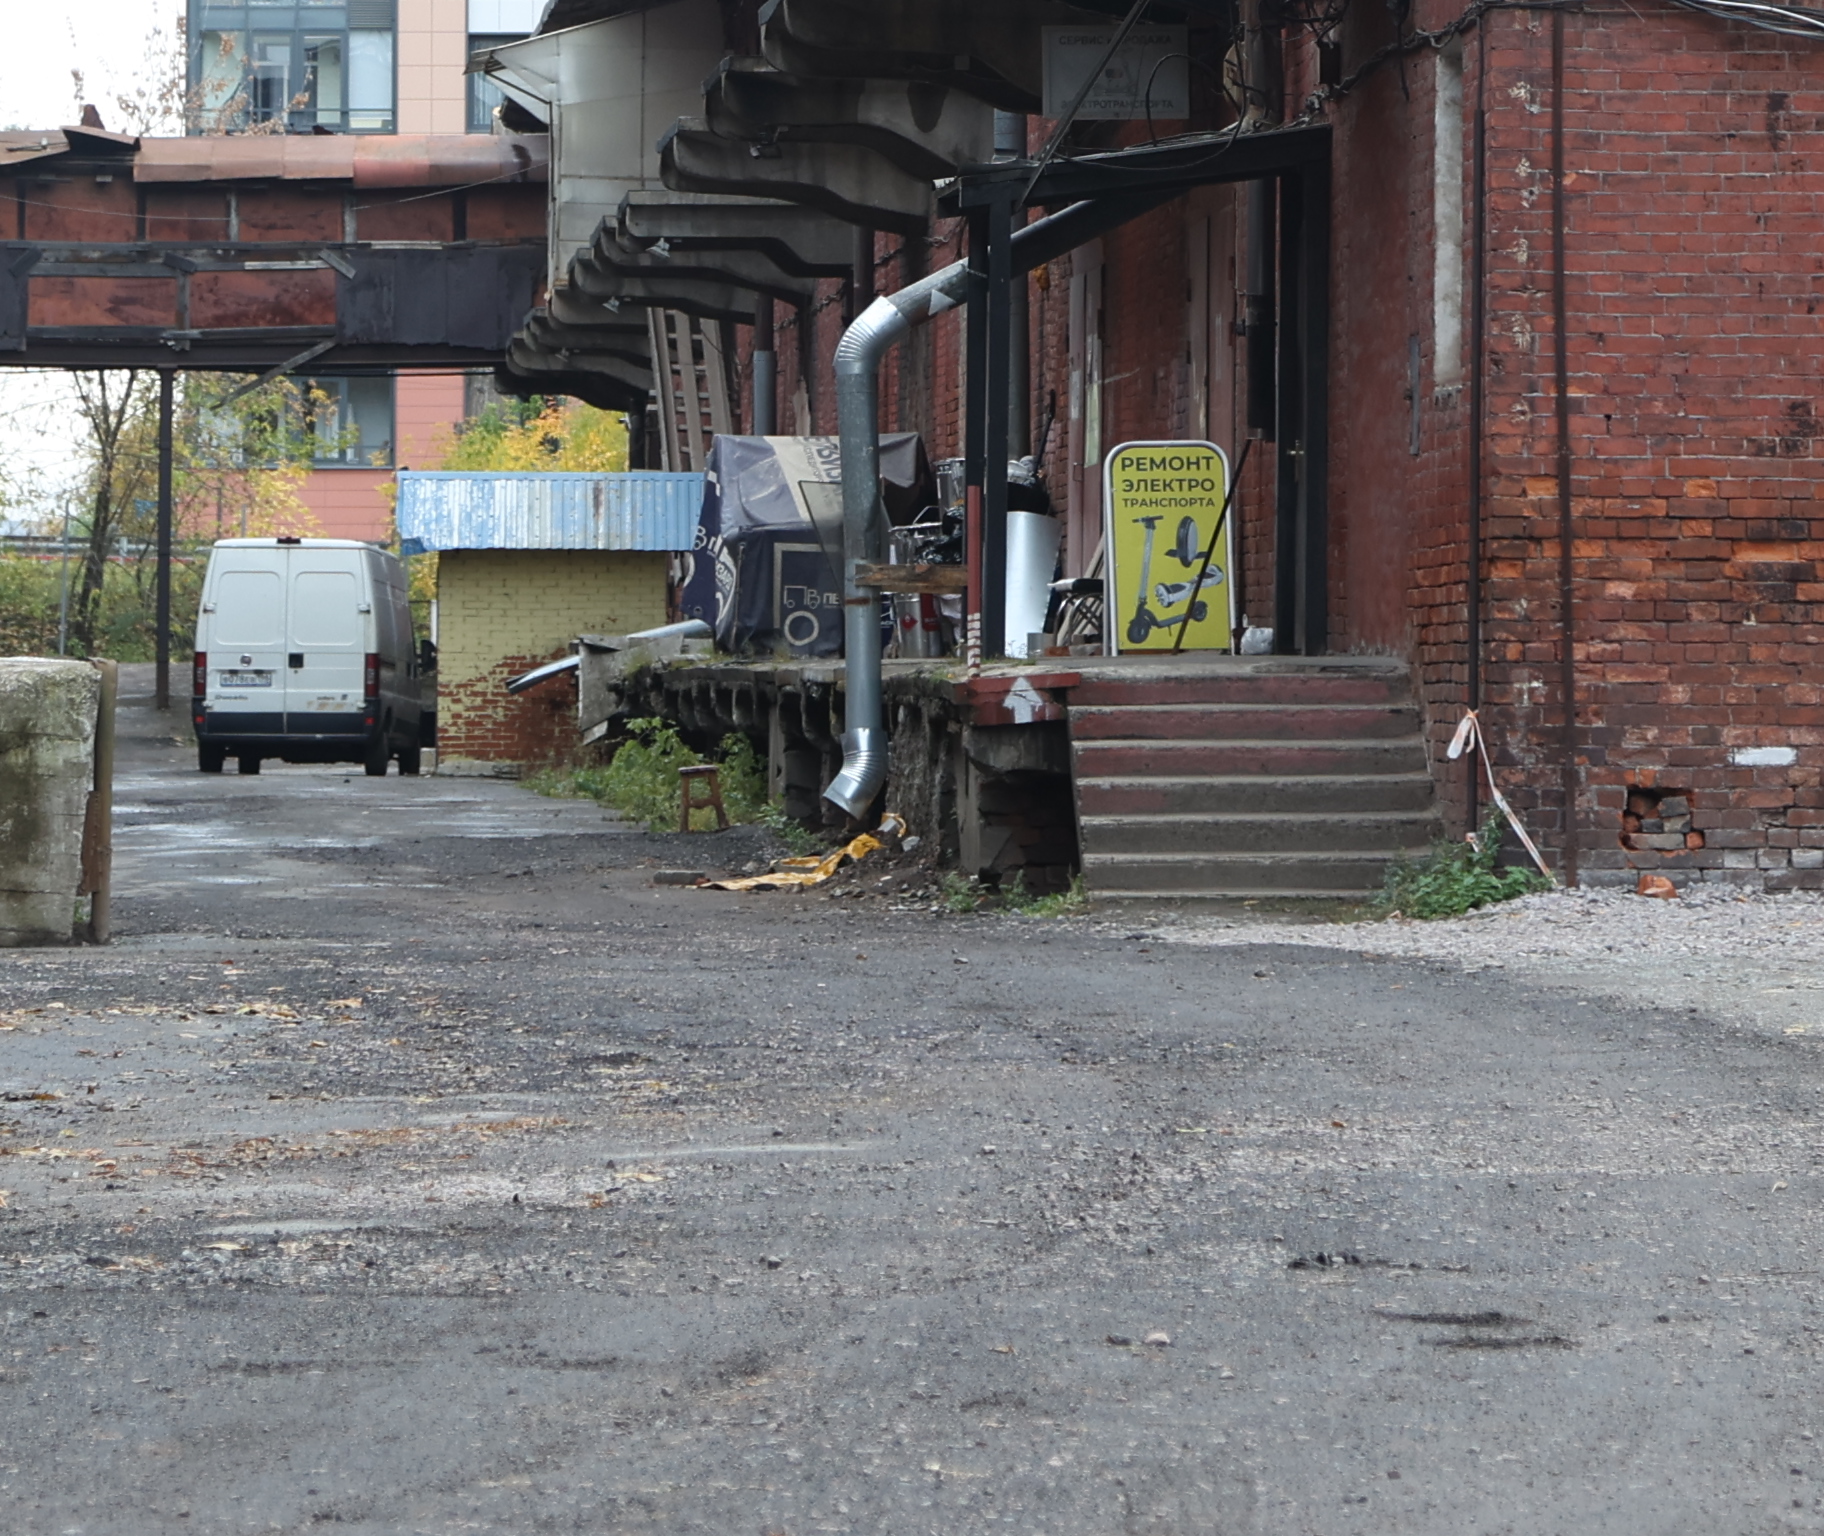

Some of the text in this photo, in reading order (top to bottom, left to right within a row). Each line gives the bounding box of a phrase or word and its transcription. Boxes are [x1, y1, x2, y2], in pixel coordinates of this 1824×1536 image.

[1118, 35, 1172, 46] РОДАЖА
[1121, 456, 1213, 472] РЕМОНТ
[1123, 479, 1215, 492] ЭЛЕКТРО
[1123, 498, 1215, 508] ТРАНСПОРТА
